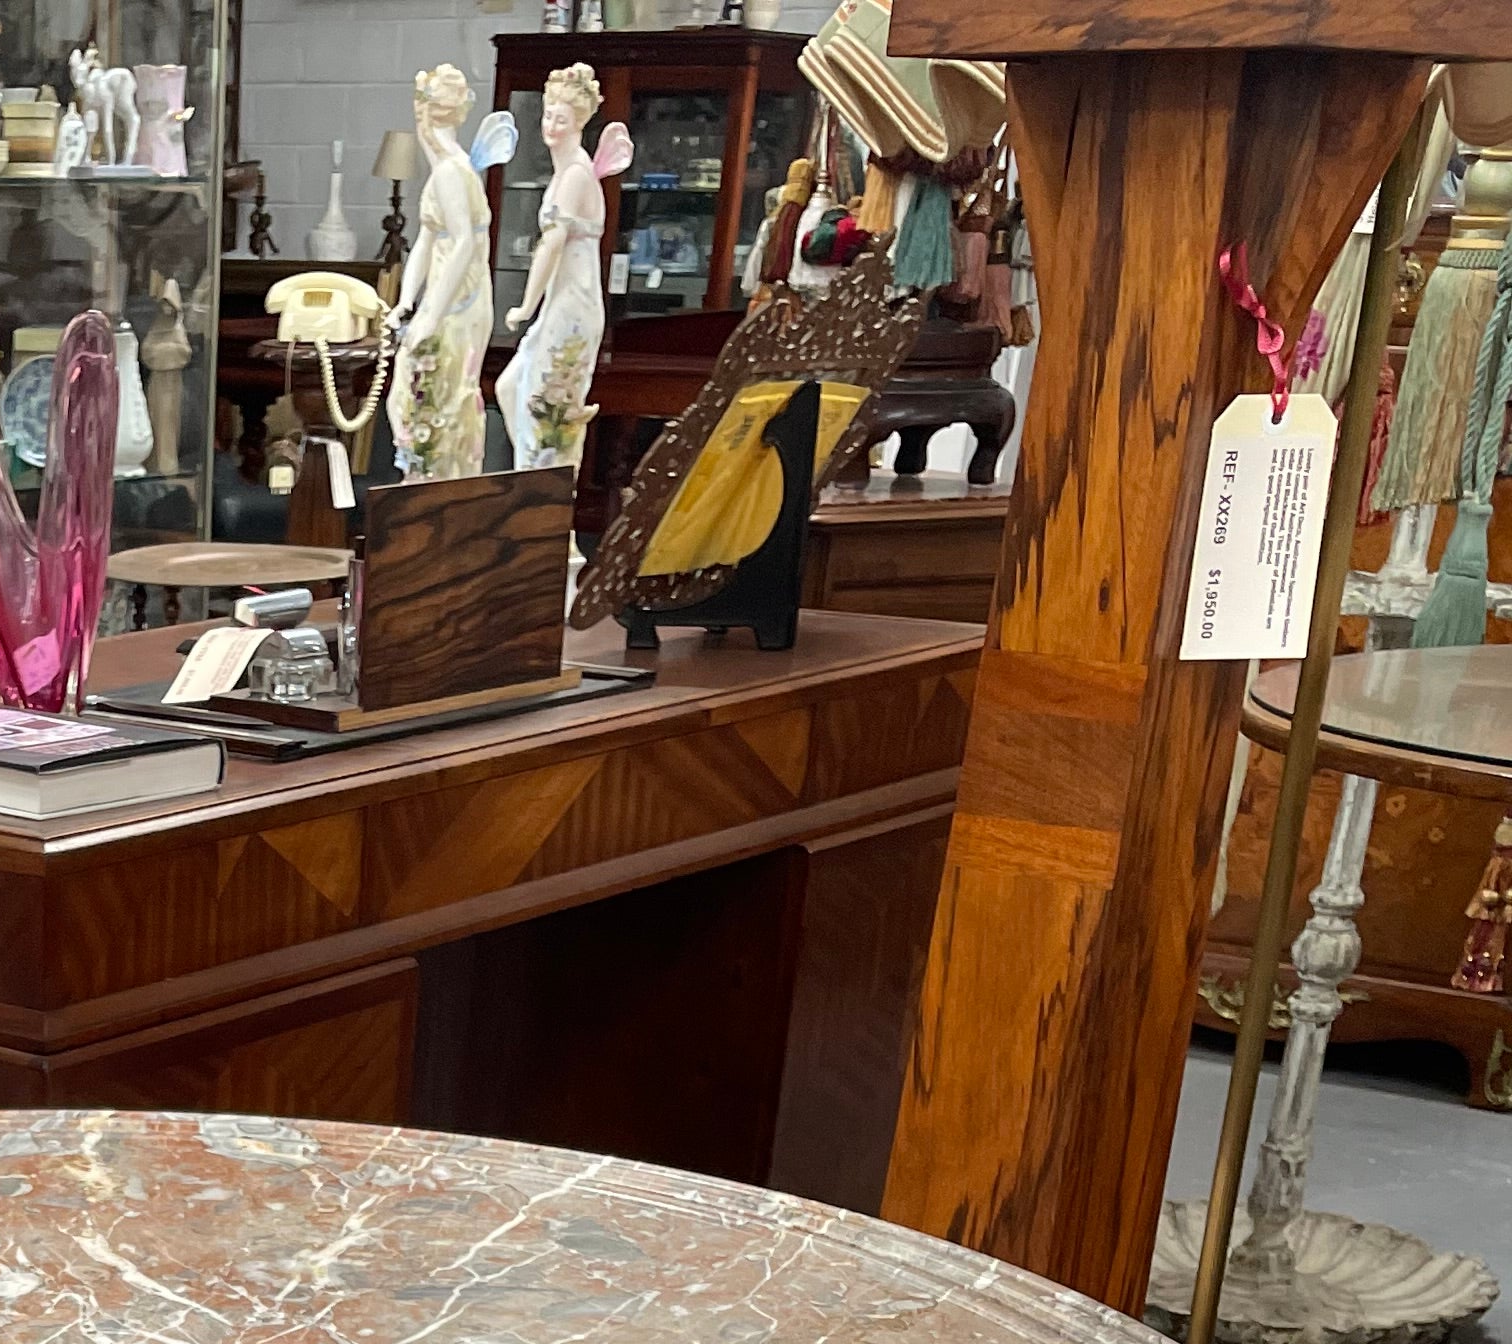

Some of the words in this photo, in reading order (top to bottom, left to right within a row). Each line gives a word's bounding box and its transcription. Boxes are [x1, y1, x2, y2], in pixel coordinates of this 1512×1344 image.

[1222, 450, 1239, 490] REF-
[1213, 494, 1232, 544] XX269
[1201, 569, 1221, 639] $1,950.00
